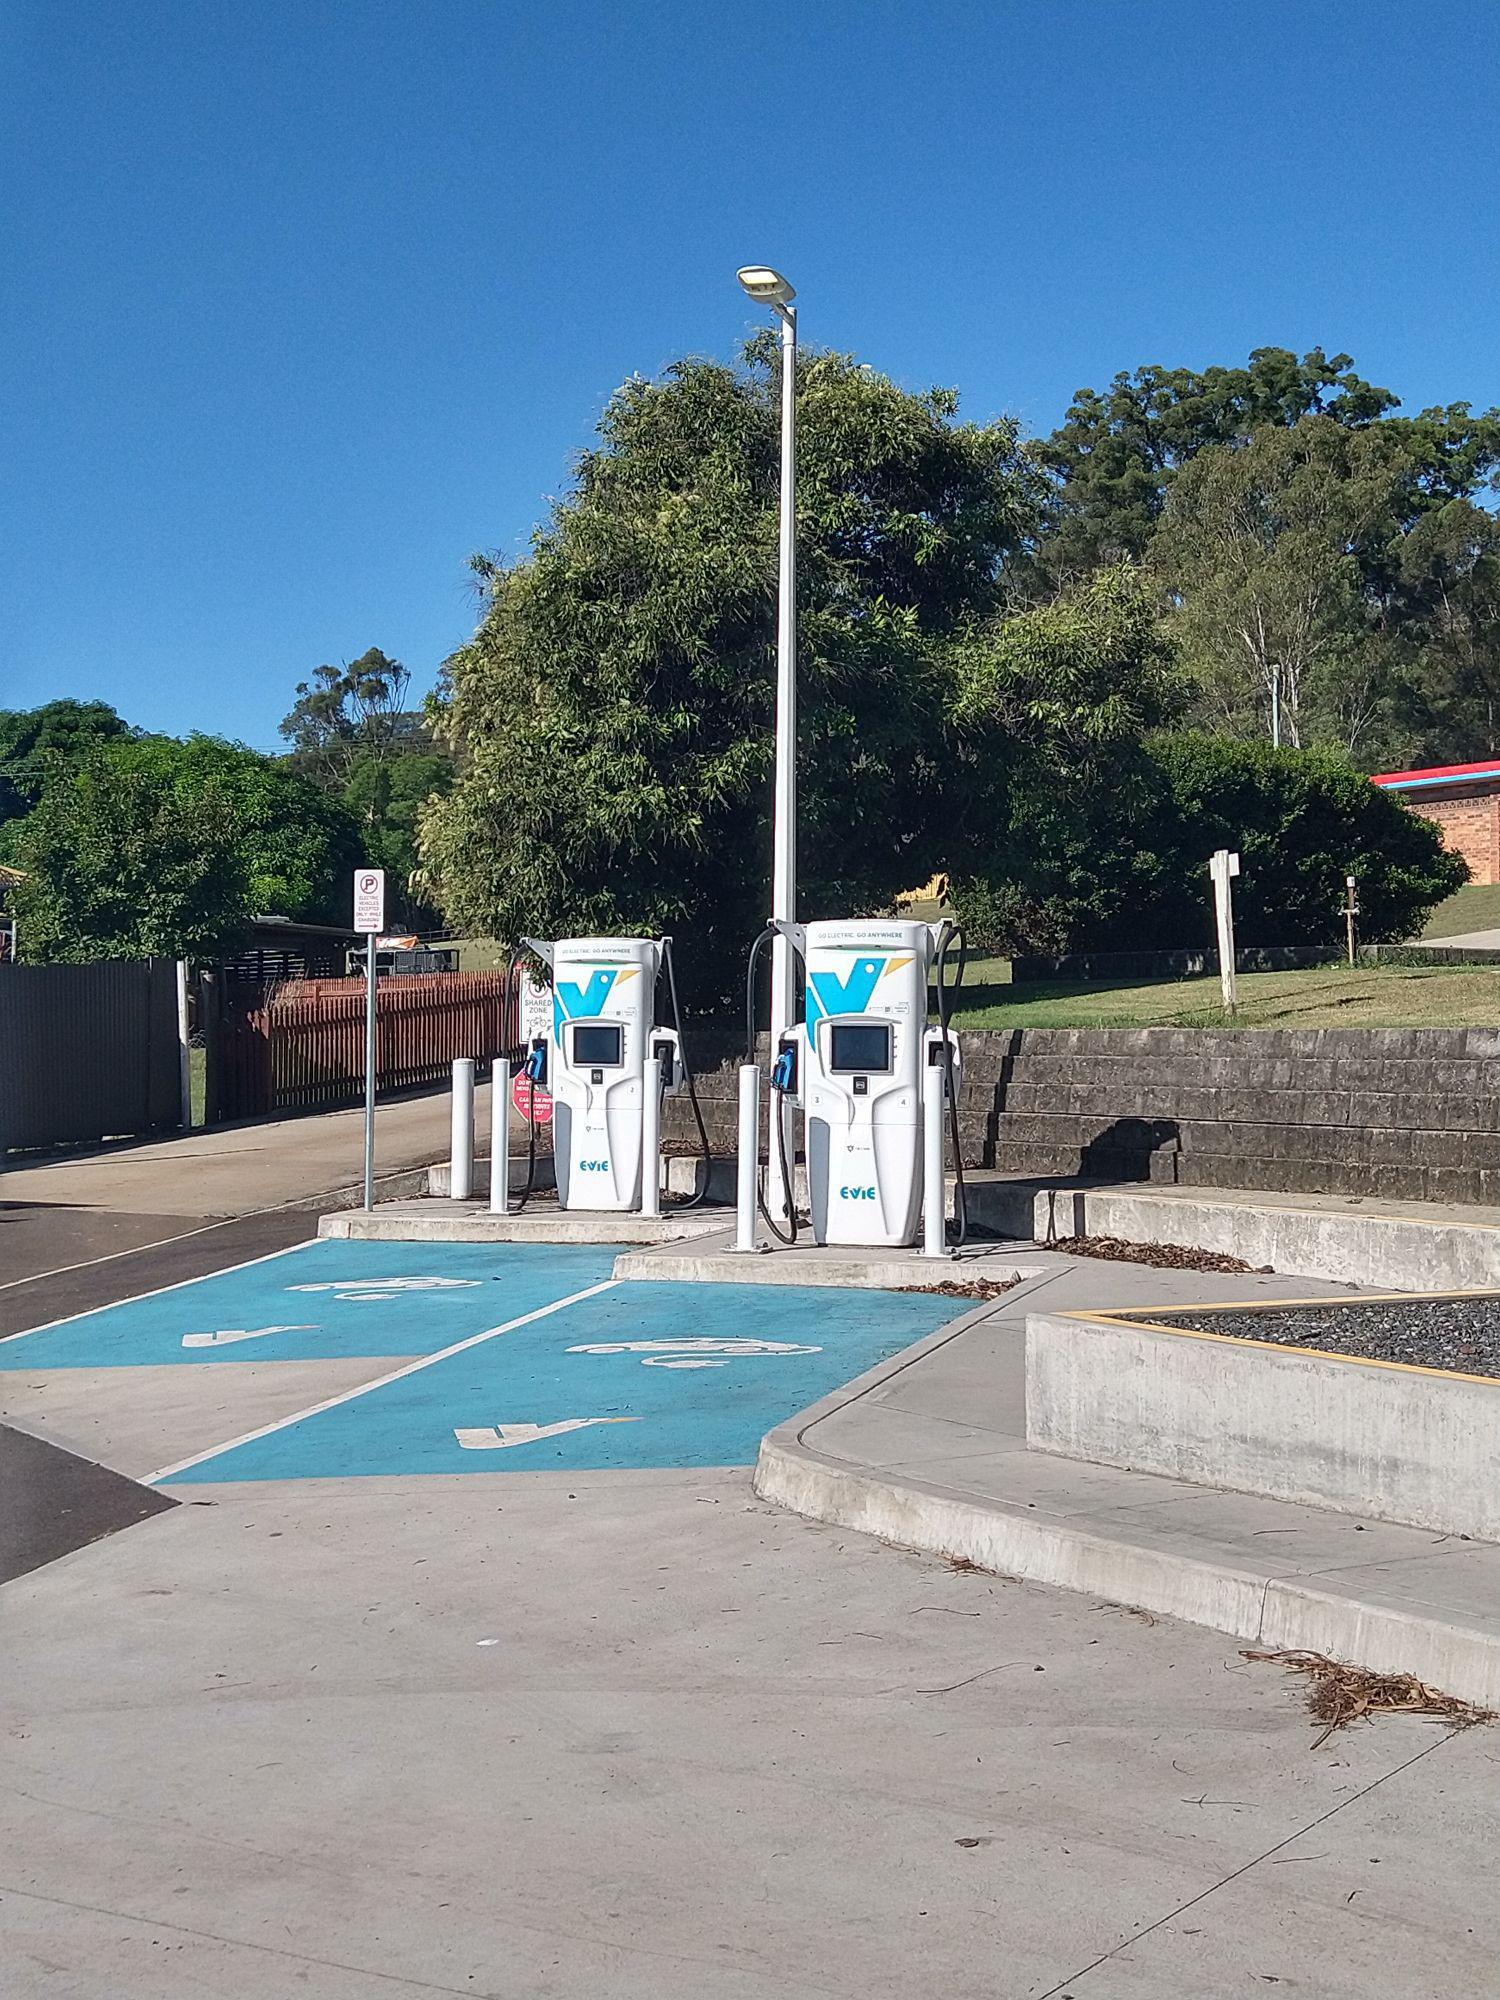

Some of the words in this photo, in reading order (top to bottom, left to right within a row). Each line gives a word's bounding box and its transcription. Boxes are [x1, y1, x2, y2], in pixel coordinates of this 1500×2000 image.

[524, 999, 553, 1007] SHARED
[529, 1006, 548, 1014] ZONE
[579, 1160, 609, 1172] EVIE
[839, 1186, 876, 1200] EVIE
